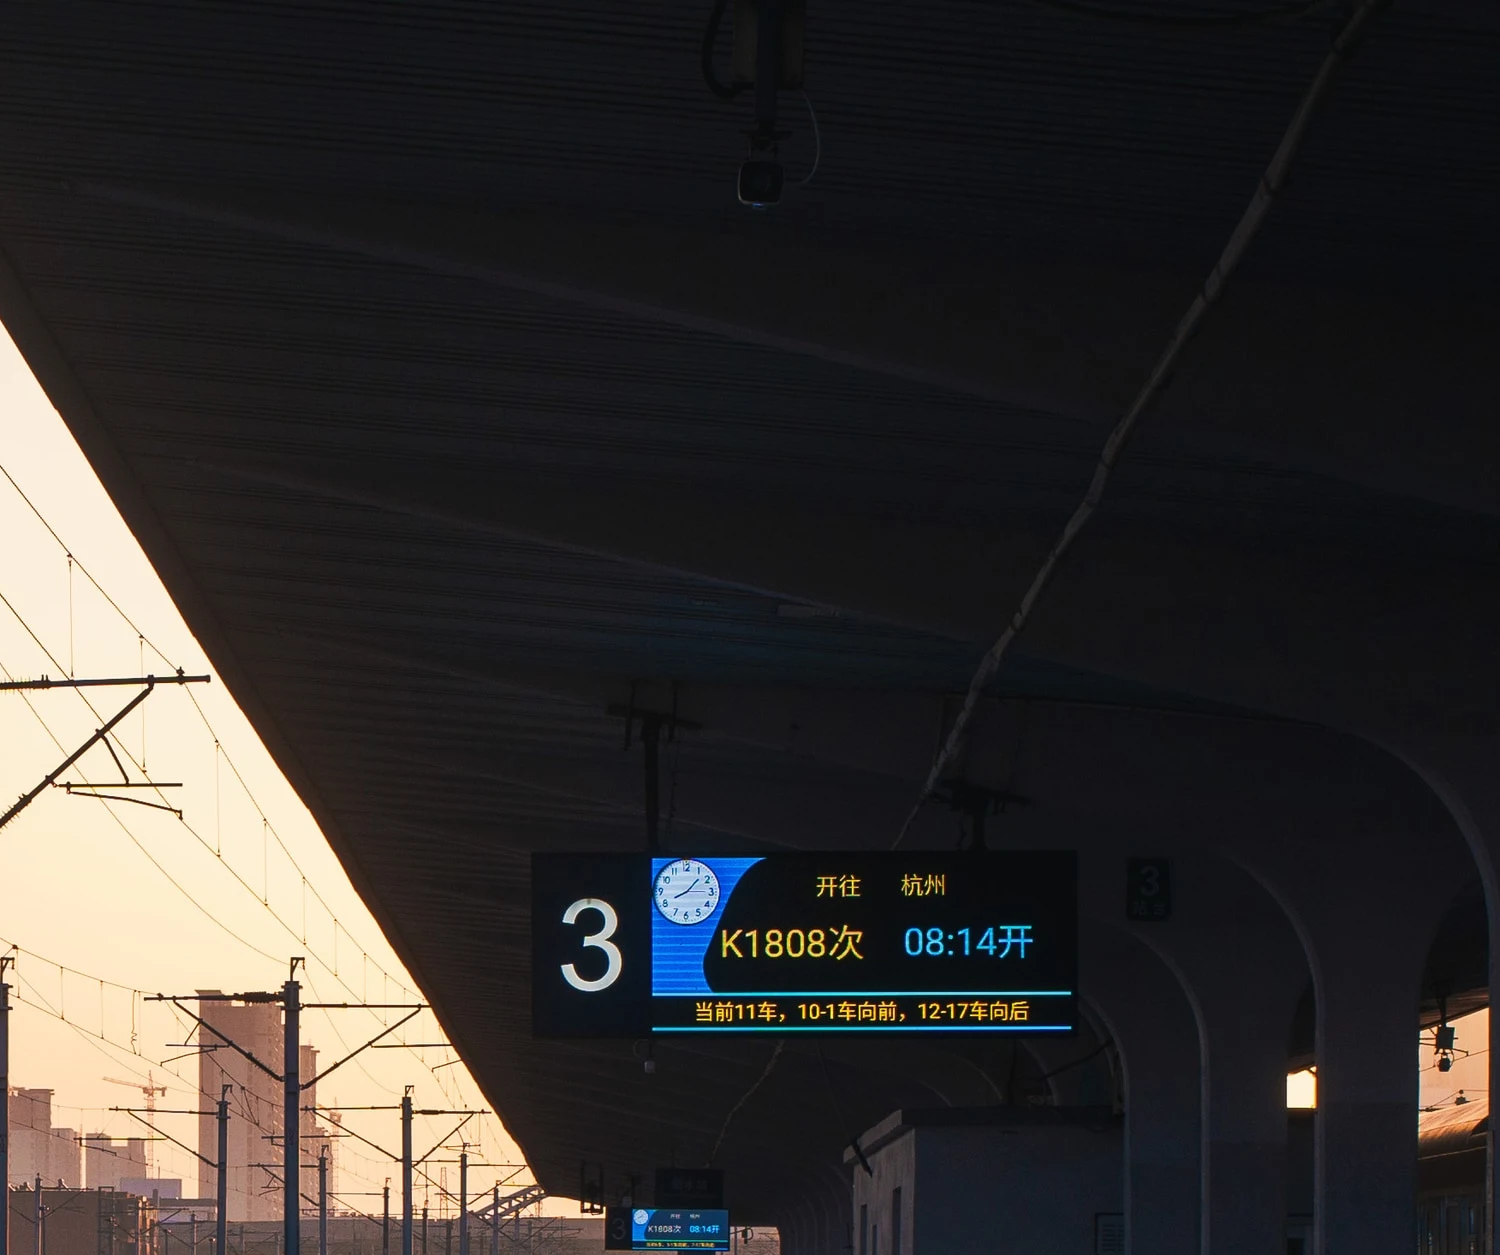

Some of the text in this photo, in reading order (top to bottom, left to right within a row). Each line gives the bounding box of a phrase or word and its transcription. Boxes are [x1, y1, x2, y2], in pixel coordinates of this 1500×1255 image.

[816, 874, 945, 898] 开往 杭州
[1139, 866, 1160, 896] 3
[1132, 899, 1165, 916] 站台
[560, 898, 622, 992] 3
[721, 925, 1034, 960] K1808次 08:14开
[611, 1217, 627, 1240] 3
